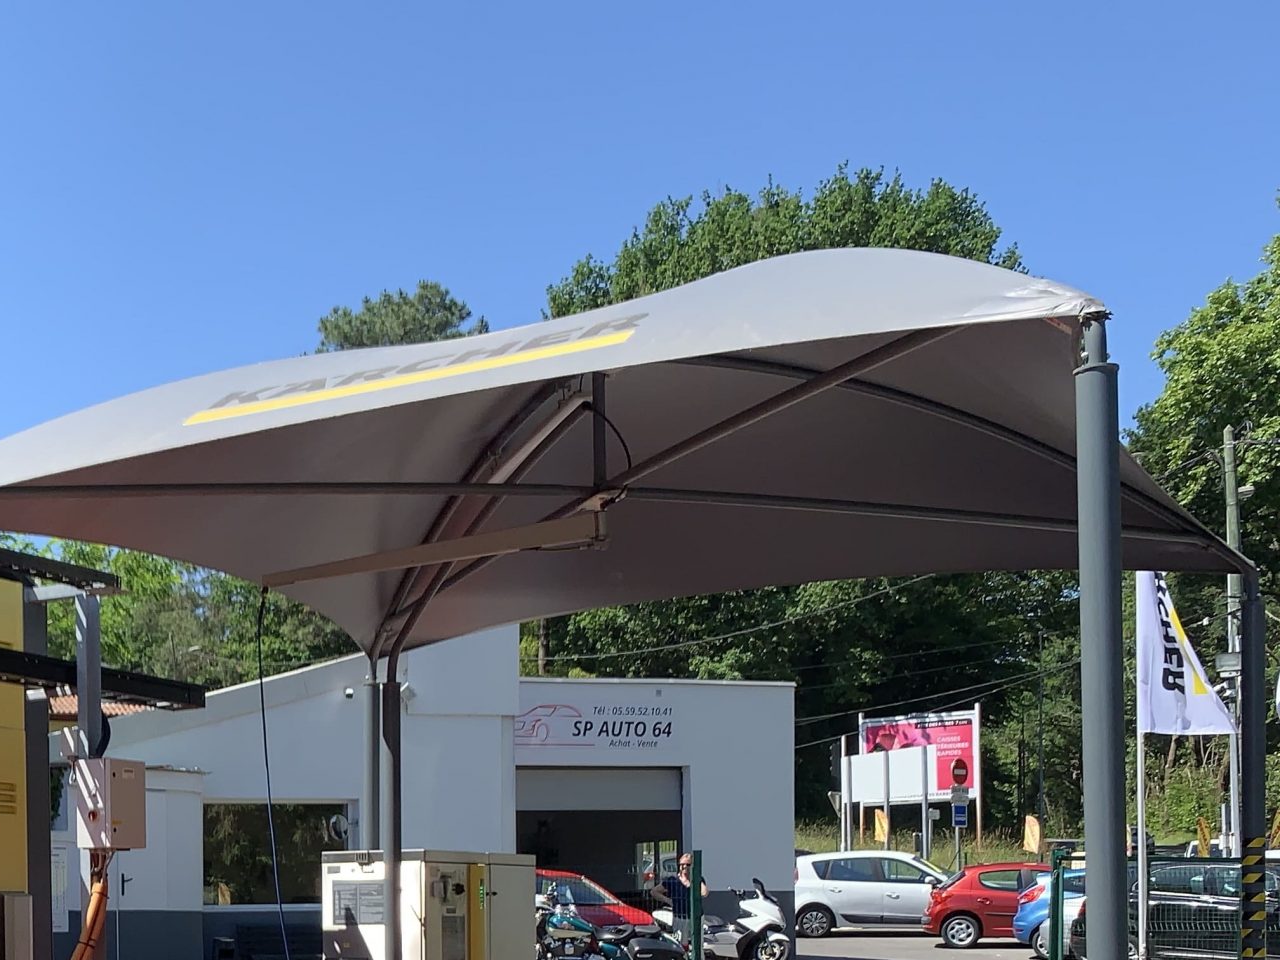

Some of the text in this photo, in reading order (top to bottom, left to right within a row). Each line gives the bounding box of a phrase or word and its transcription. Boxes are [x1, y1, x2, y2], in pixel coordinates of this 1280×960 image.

[593, 706, 605, 716] Tél
[612, 706, 673, 716] 05.59.52.10.41
[572, 721, 672, 738] SP AUTO 64
[609, 739, 631, 748] Achat
[637, 739, 658, 748] Vente
